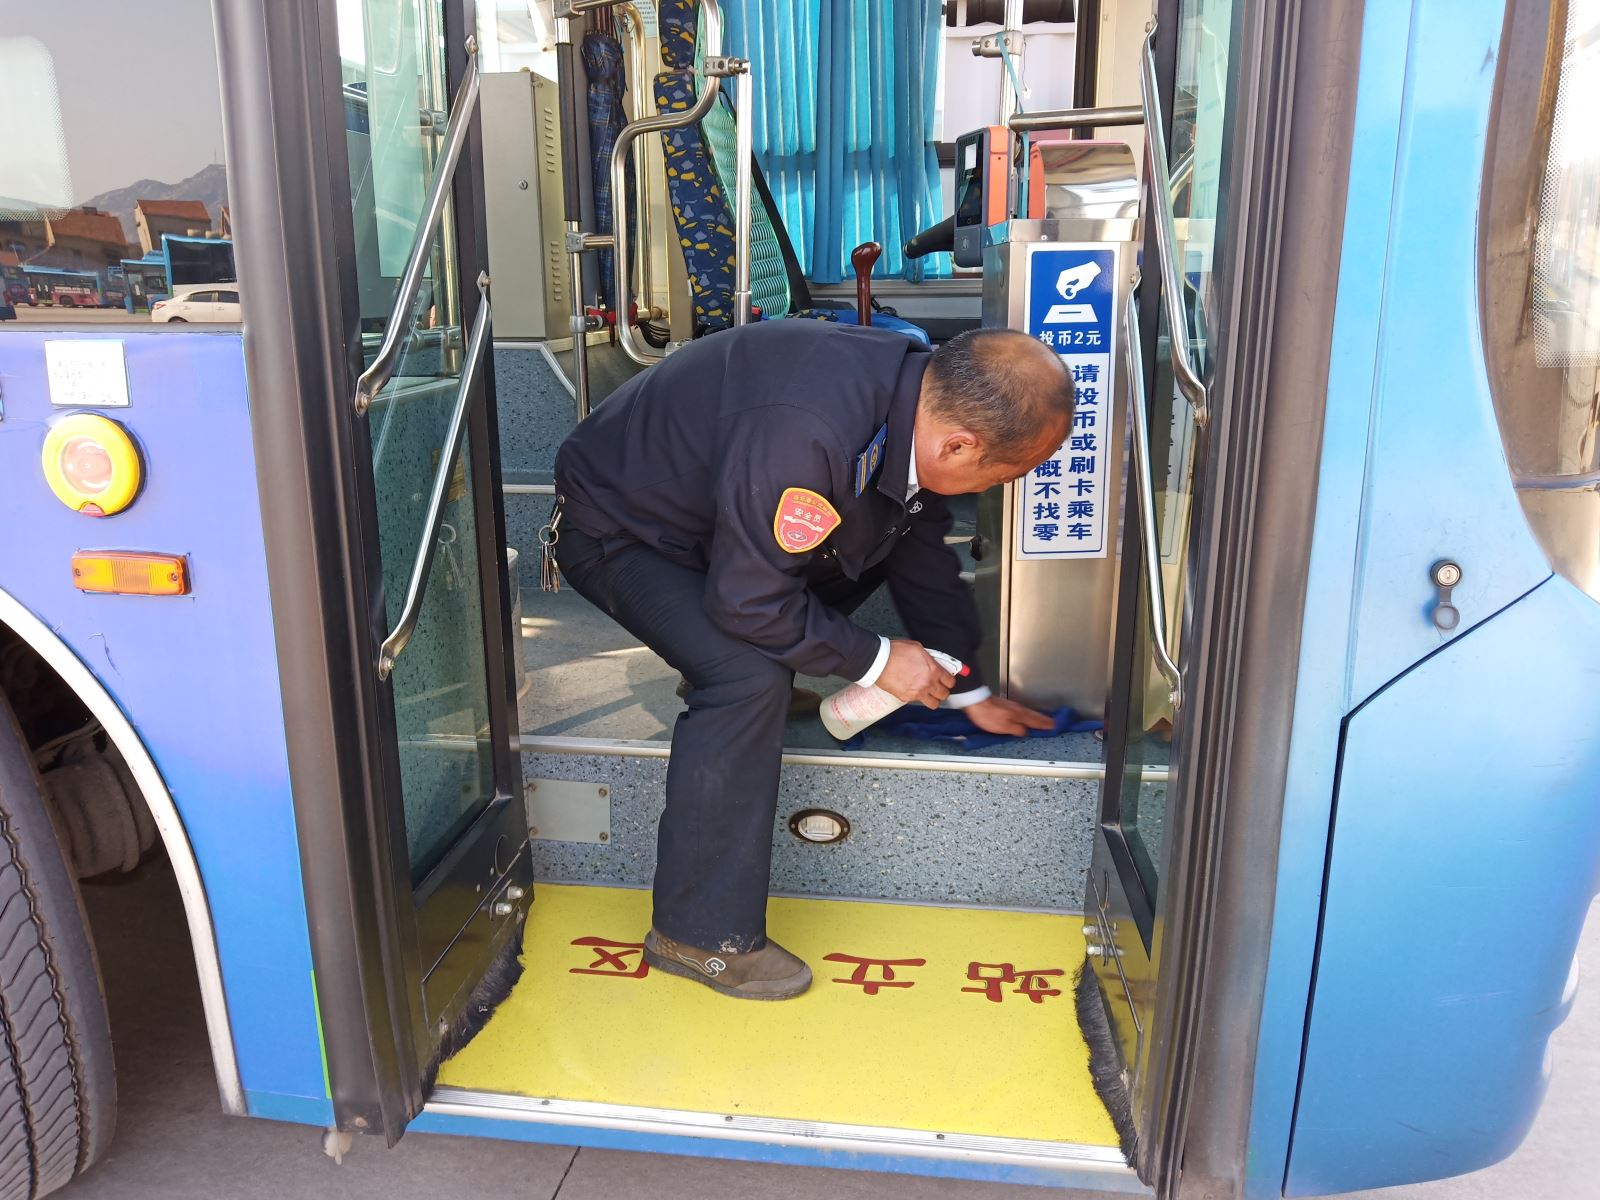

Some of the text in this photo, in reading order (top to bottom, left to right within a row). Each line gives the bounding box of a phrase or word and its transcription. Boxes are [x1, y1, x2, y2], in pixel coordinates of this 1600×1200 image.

[1039, 330, 1102, 346] 投币2元
[1032, 445, 1063, 541] 概不找零
[1067, 364, 1100, 540] 请投币或刷卡乘车
